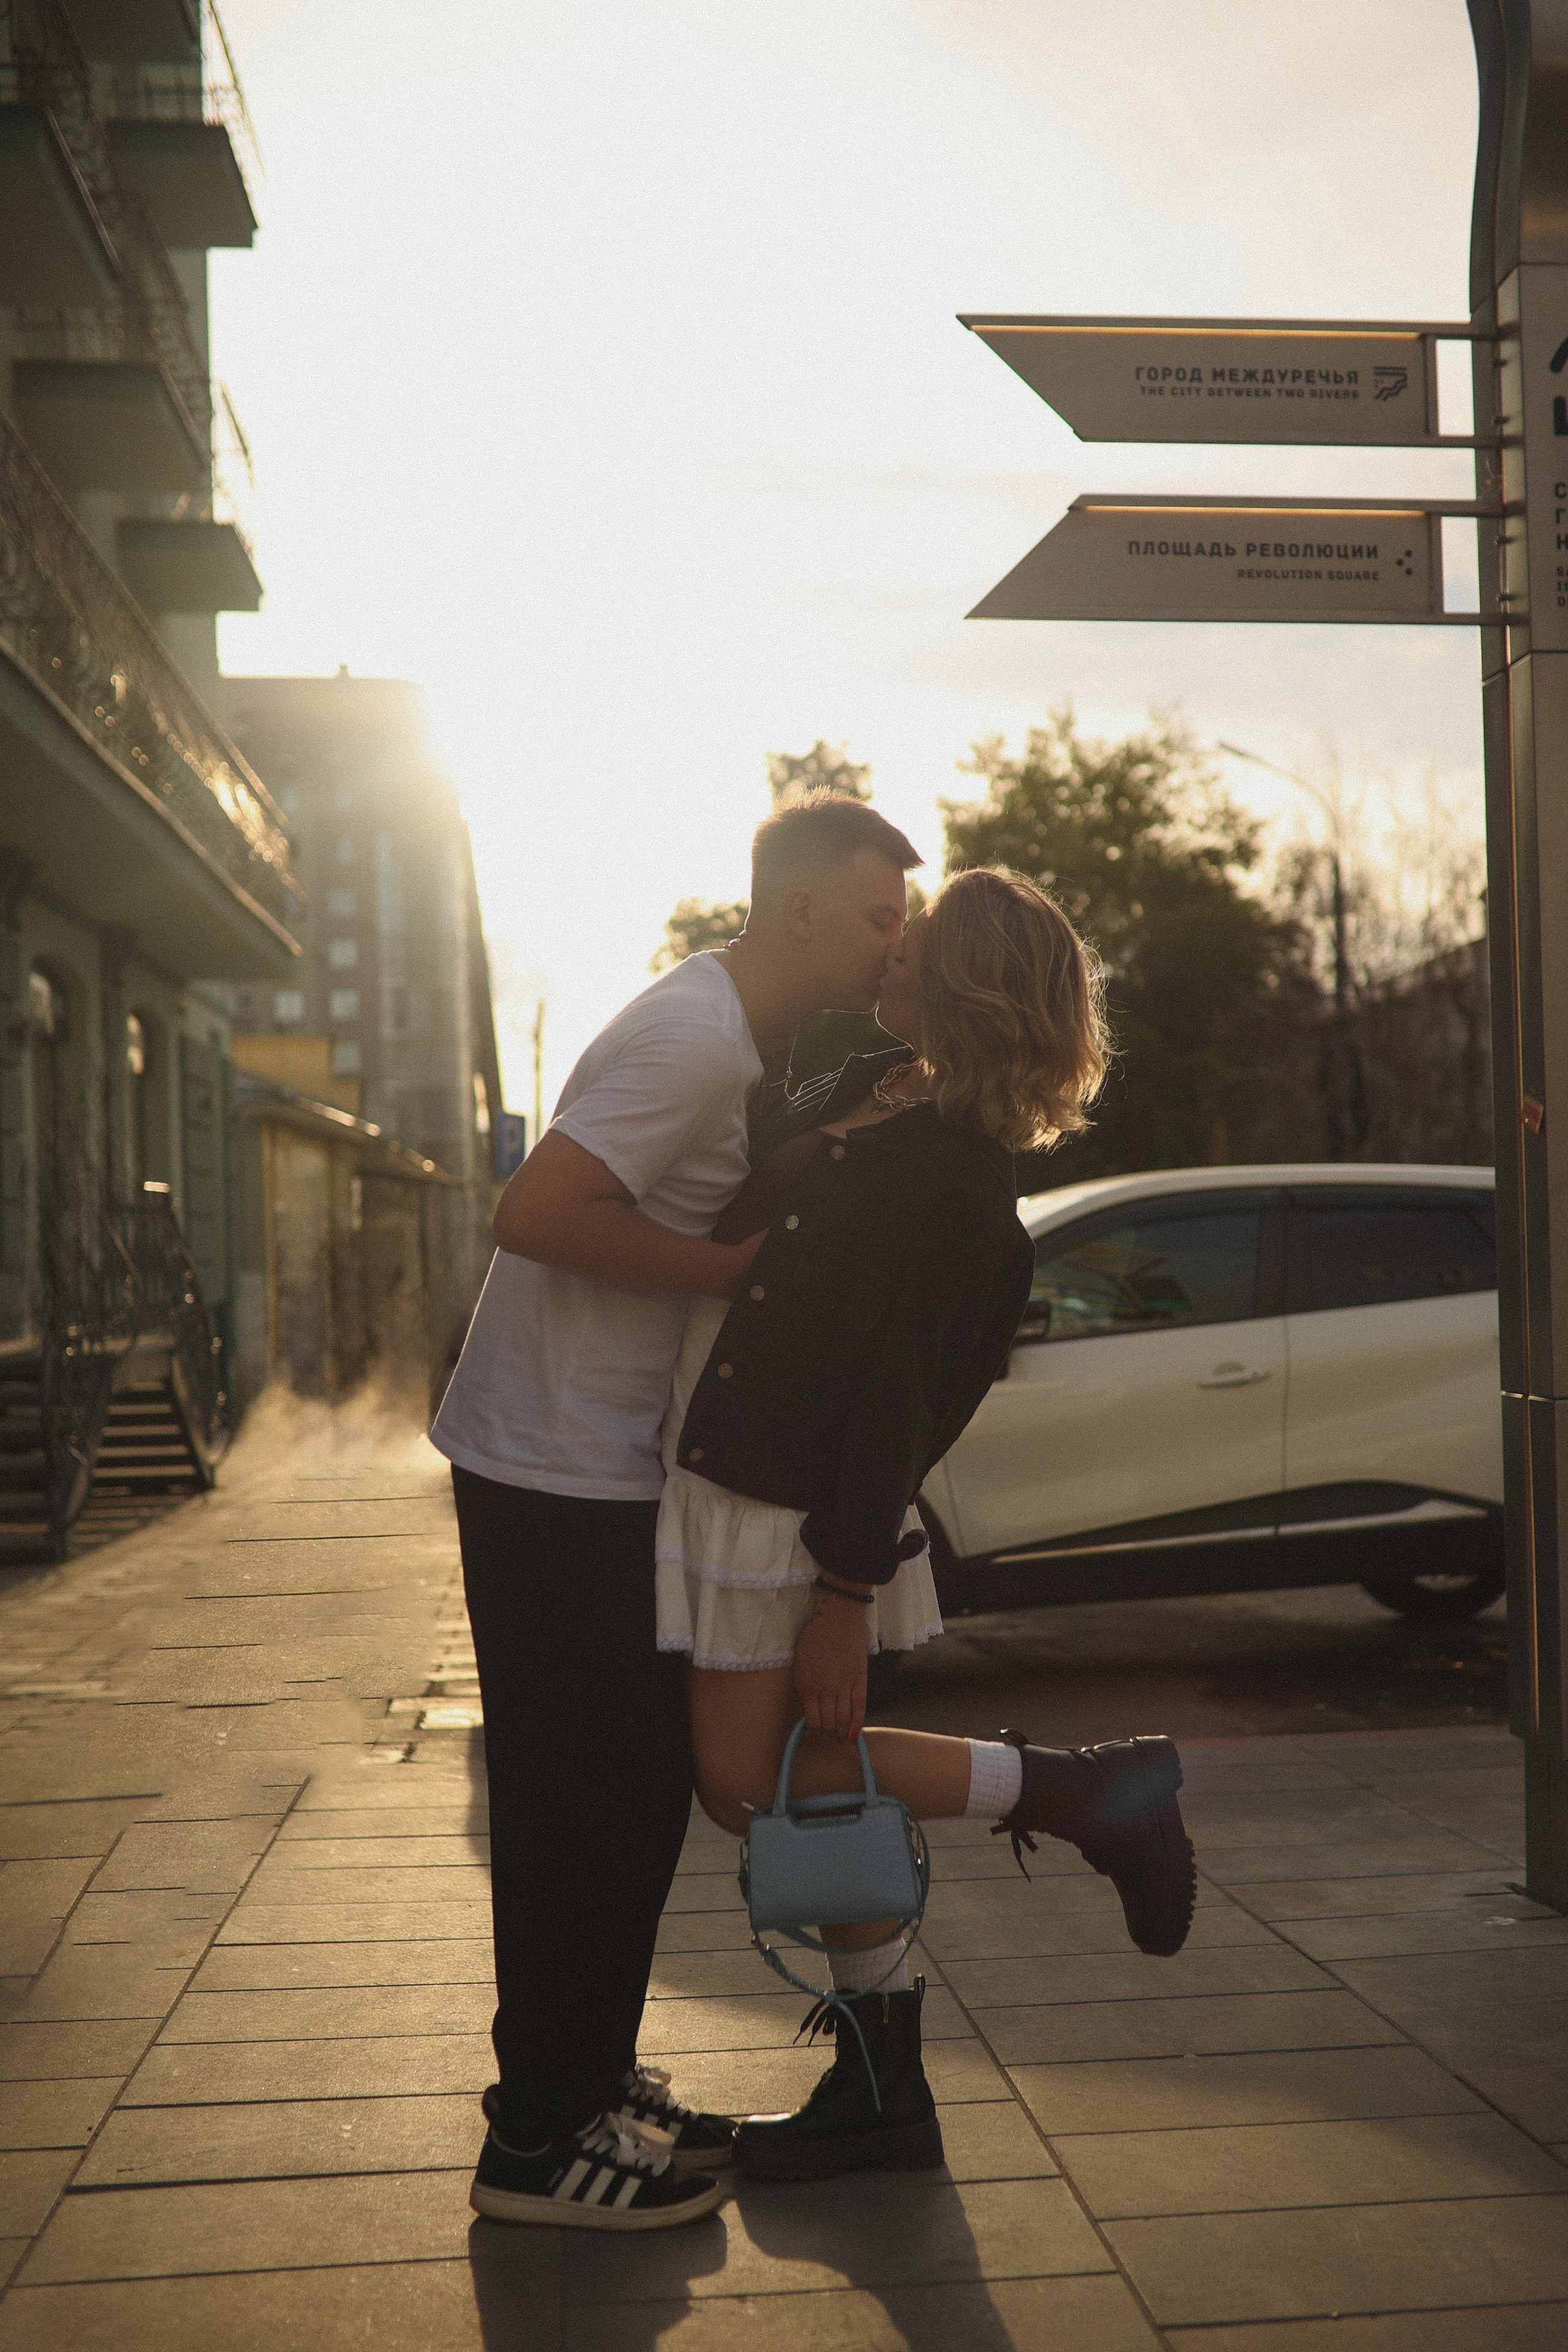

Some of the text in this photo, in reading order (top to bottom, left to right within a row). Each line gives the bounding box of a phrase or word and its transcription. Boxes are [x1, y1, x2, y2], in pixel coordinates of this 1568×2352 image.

[1135, 367, 1358, 384] ГОРОД МЕЖДУРЕЧЬЯ
[1140, 386, 1358, 399] THE CITY BETWEEN TWO RIVERS
[1128, 540, 1377, 560] ПЛОЩАДЬ РЕВОЛЮЦИИ
[1237, 569, 1378, 581] REVOLUTION SQUARE
